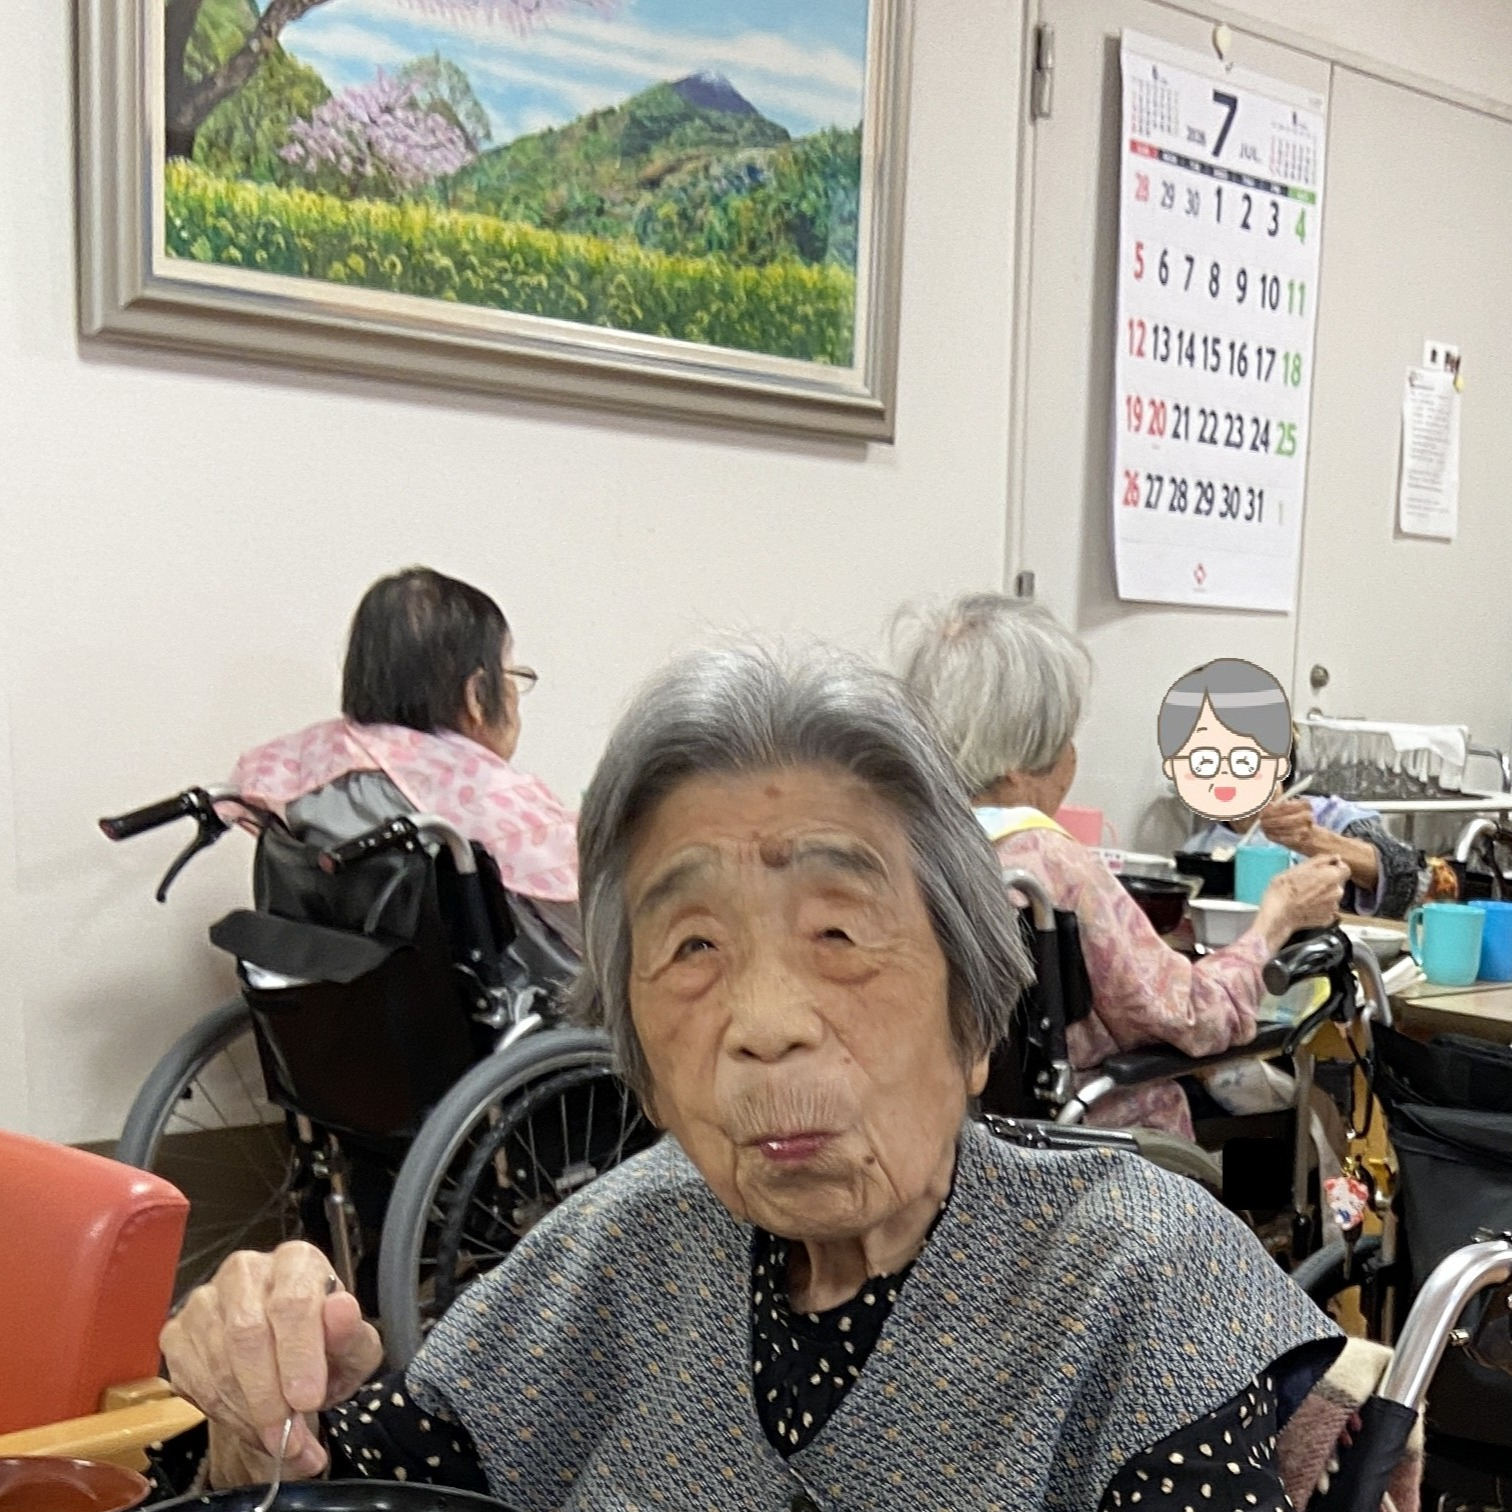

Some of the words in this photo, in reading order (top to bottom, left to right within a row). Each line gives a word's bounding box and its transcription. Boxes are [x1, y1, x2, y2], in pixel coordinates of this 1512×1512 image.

[1212, 89, 1238, 157] 7
[1215, 186, 1224, 223] 1
[1241, 194, 1253, 231] 2
[1267, 201, 1280, 237] 3
[1295, 207, 1307, 244] 4
[1133, 241, 1146, 280] 5
[1158, 249, 1170, 286] 6
[1184, 255, 1196, 292] 7
[1208, 262, 1221, 298] 8
[1236, 268, 1248, 303] 9
[1260, 274, 1281, 311] 10
[1287, 280, 1306, 316] 11
[1127, 319, 1147, 359] 12
[1152, 325, 1171, 363] 13
[1177, 330, 1196, 368] 14
[1202, 335, 1222, 374] 15
[1229, 341, 1249, 378] 16
[1256, 347, 1277, 383] 17
[1282, 352, 1303, 388] 18
[1125, 395, 1144, 434] 19
[1147, 400, 1168, 438] 20
[1171, 404, 1191, 441] 21
[1197, 409, 1219, 446] 22
[1224, 413, 1245, 450] 23
[1250, 418, 1271, 454] 24
[1275, 422, 1298, 458] 25
[1122, 470, 1141, 508] 26
[1144, 474, 1164, 510] 27
[1168, 478, 1189, 514] 28
[1194, 481, 1215, 517] 29
[1219, 486, 1241, 520] 30
[1245, 489, 1265, 523] 31
